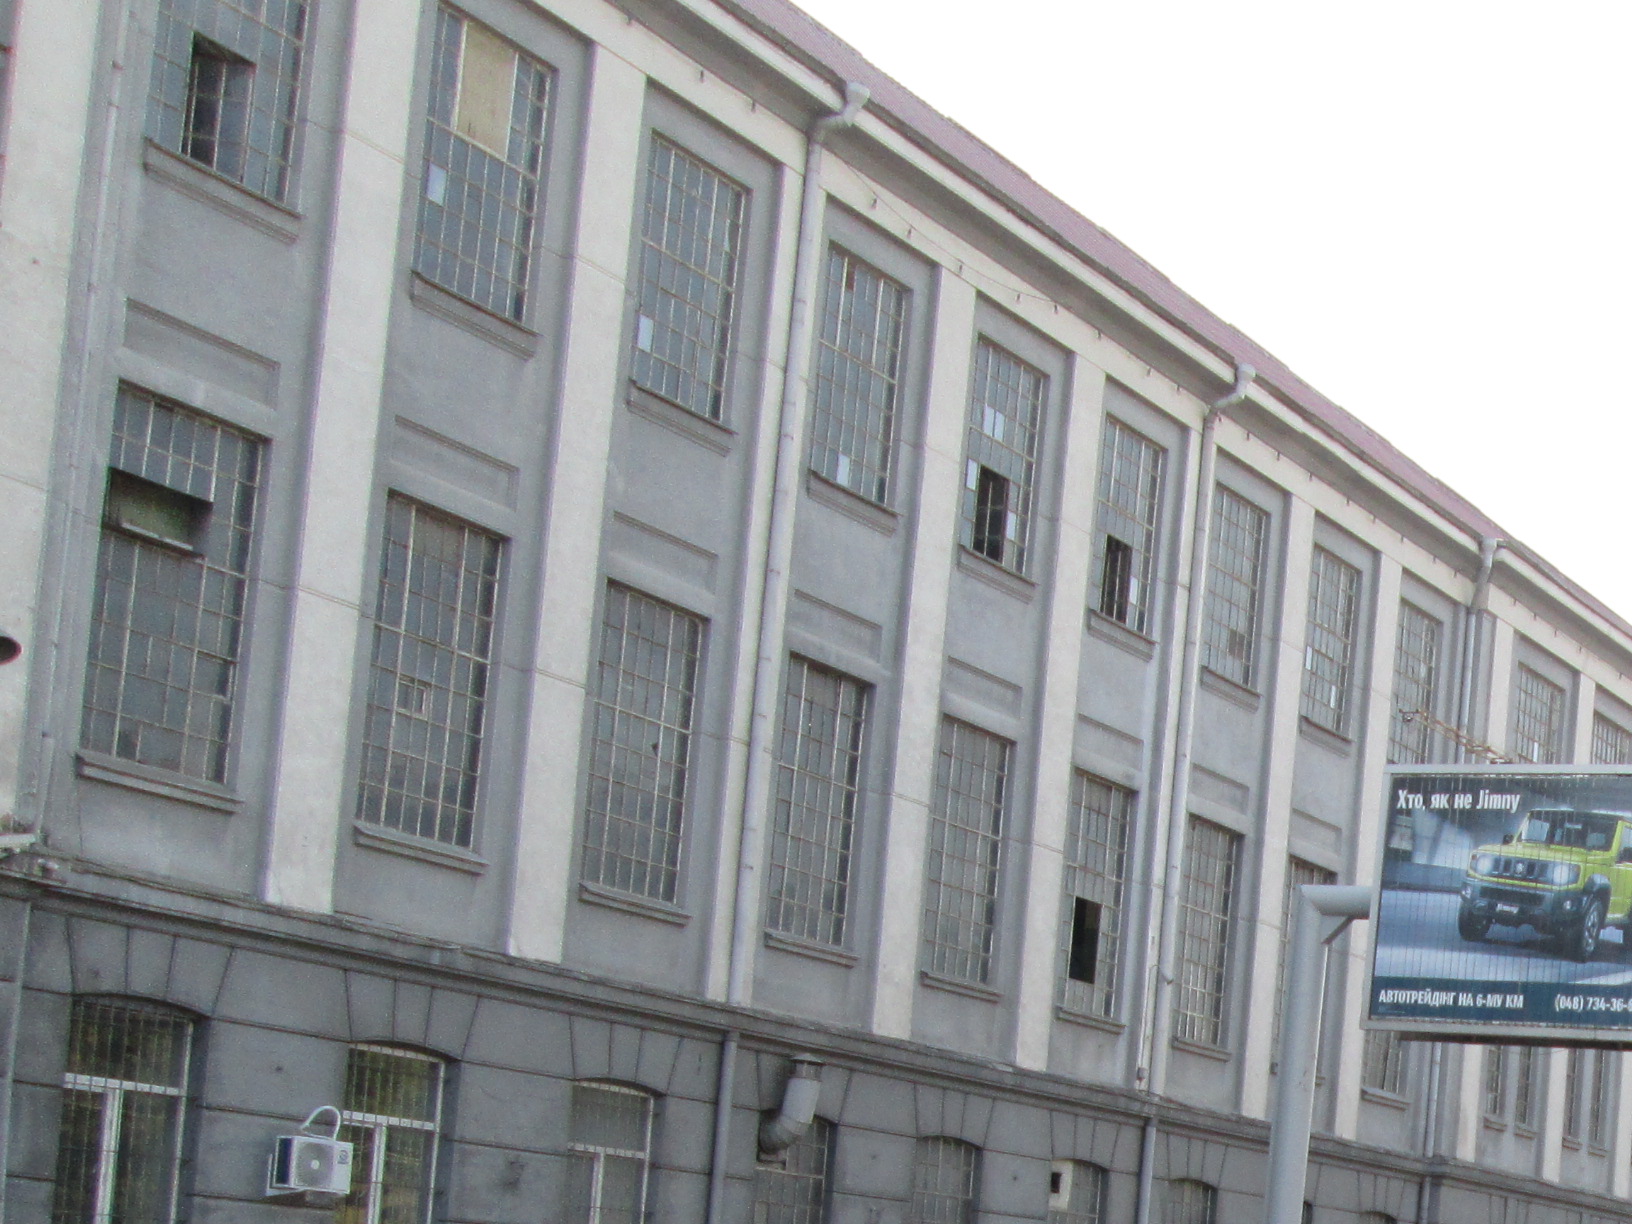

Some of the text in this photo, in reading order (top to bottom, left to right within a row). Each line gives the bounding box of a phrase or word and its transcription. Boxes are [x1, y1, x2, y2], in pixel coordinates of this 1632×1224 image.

[1396, 789, 1520, 814] Хто, як не Jimny
[1378, 988, 1457, 1007] АВТОТРЕЙДІНГ
[1458, 996, 1475, 1007] НА
[1476, 994, 1503, 1008] 6-МУ
[1505, 995, 1525, 1009] КМ
[1554, 994, 1584, 1013] (048)
